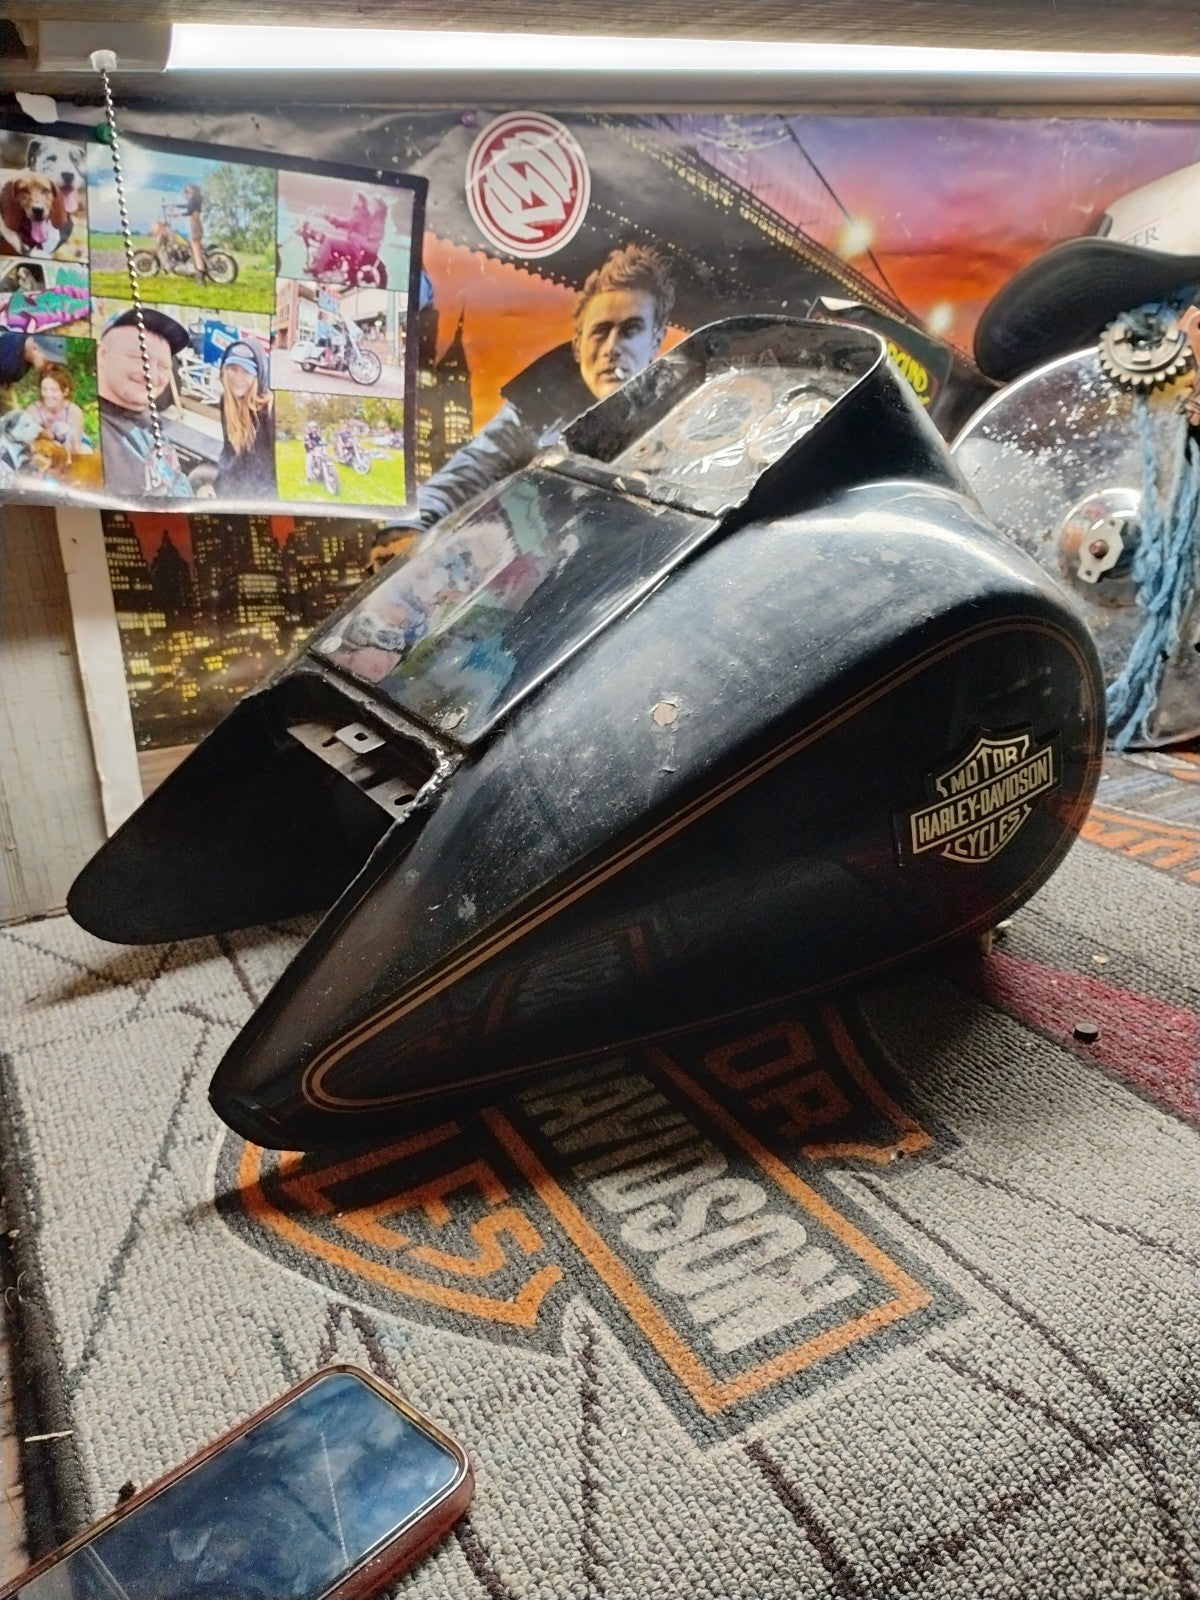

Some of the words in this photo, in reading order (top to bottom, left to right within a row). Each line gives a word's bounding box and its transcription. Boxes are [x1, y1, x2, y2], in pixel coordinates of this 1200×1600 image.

[950, 746, 1018, 794] MOTOR
[918, 756, 1048, 844] HARLEY-DAVIDSON
[954, 808, 1021, 857] CYCLES
